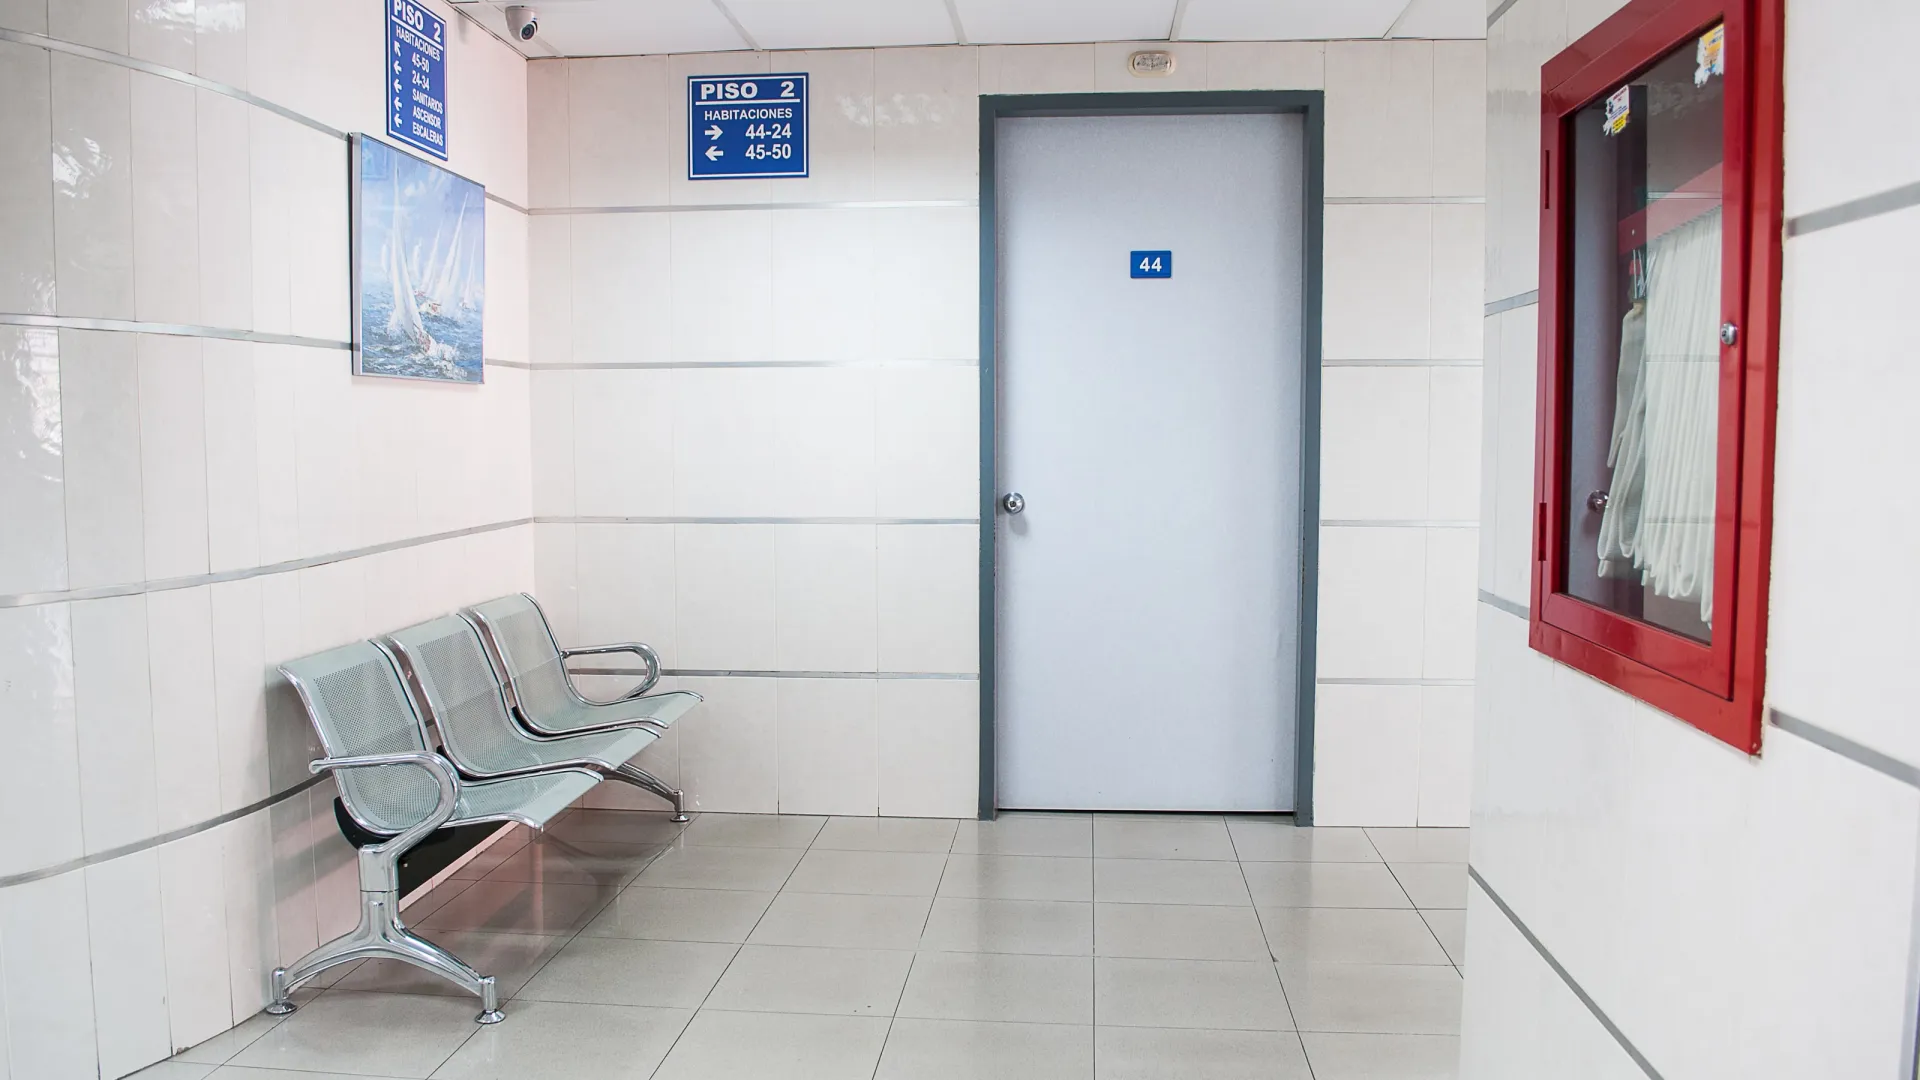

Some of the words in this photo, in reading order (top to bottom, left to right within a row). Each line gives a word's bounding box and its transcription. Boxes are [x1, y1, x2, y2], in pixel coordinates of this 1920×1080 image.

[394, 0, 424, 31] PISO
[433, 22, 441, 43] 2
[395, 24, 441, 62] HABITACIONES
[411, 52, 430, 73] 45-50
[411, 69, 430, 91] 24-34
[700, 82, 758, 100] PISO
[780, 81, 795, 97] 2
[412, 88, 443, 115] SANITARIOS
[412, 105, 442, 130] ASCENSOR
[704, 108, 793, 121] HABITACIONES
[412, 121, 444, 147] ESCALERAS
[745, 123, 792, 140] 44-24
[745, 143, 792, 160] 45-50
[1139, 256, 1162, 272] 44
